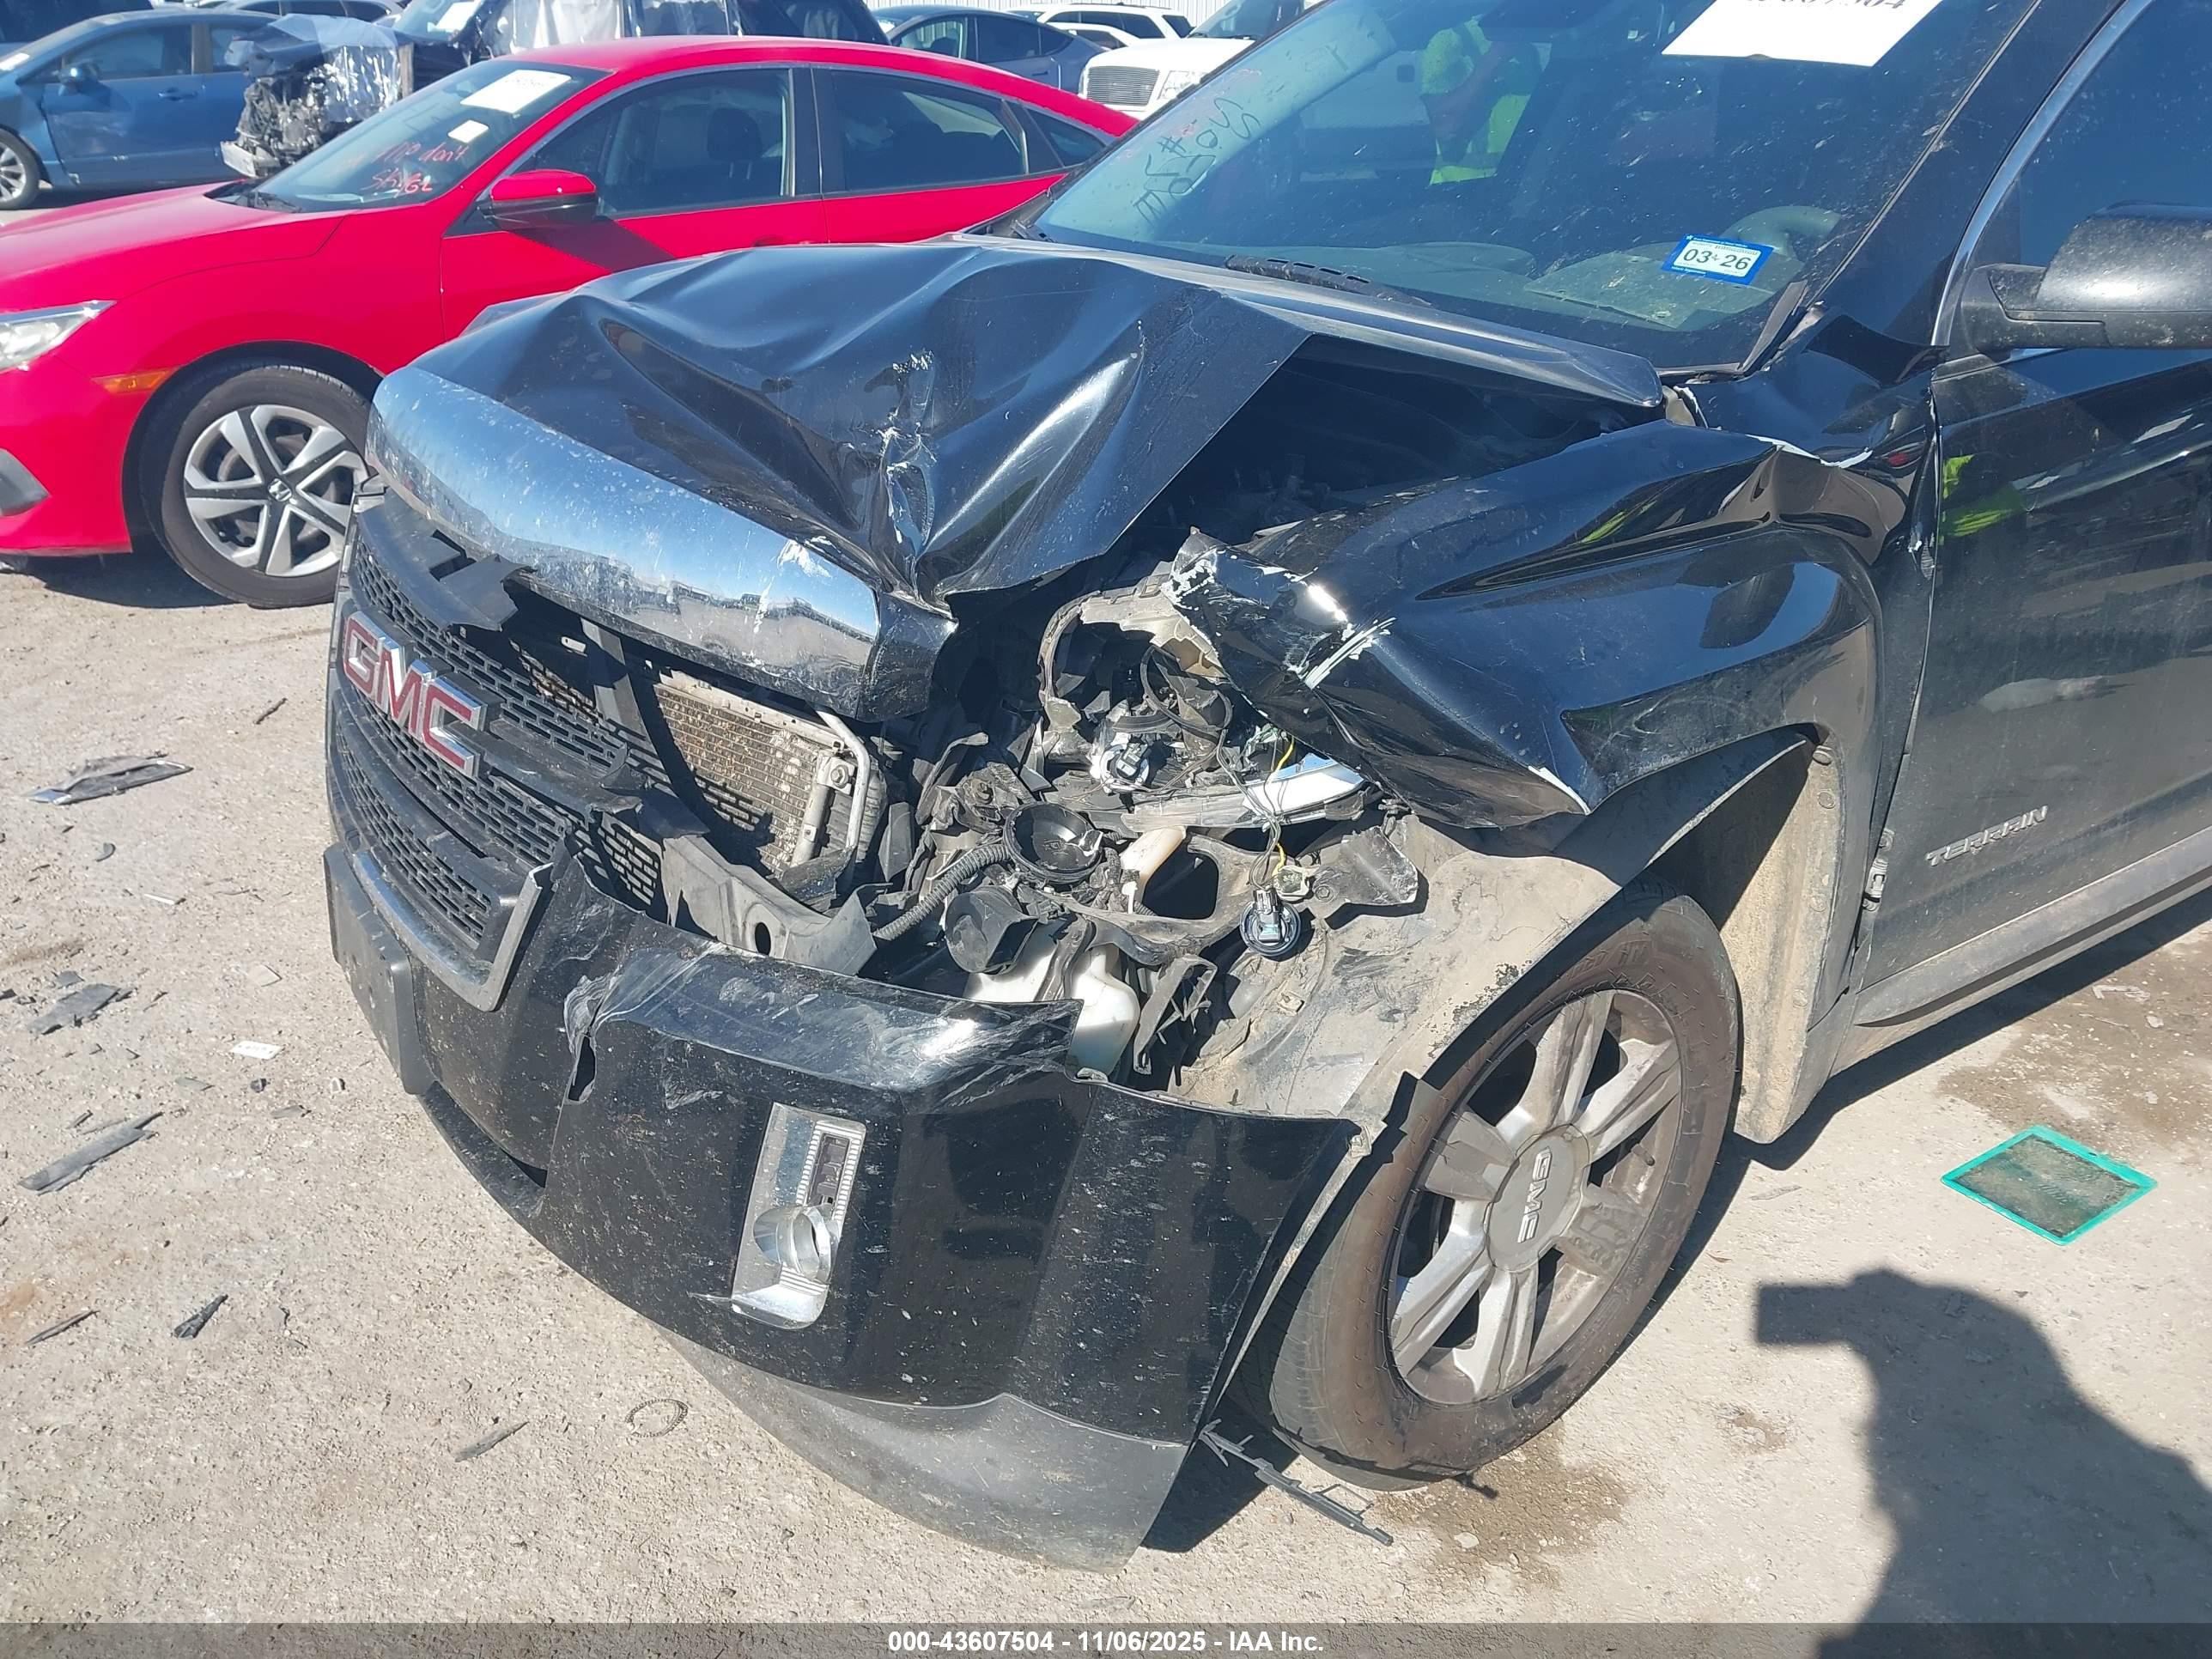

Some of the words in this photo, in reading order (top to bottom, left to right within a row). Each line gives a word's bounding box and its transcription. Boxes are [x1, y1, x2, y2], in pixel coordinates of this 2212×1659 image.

[1683, 248, 1713, 264] 03
[1719, 254, 1752, 270] 26
[344, 611, 487, 780] GMC
[1925, 805, 2049, 866] TERRAIN
[1517, 1146, 1553, 1243] GMC
